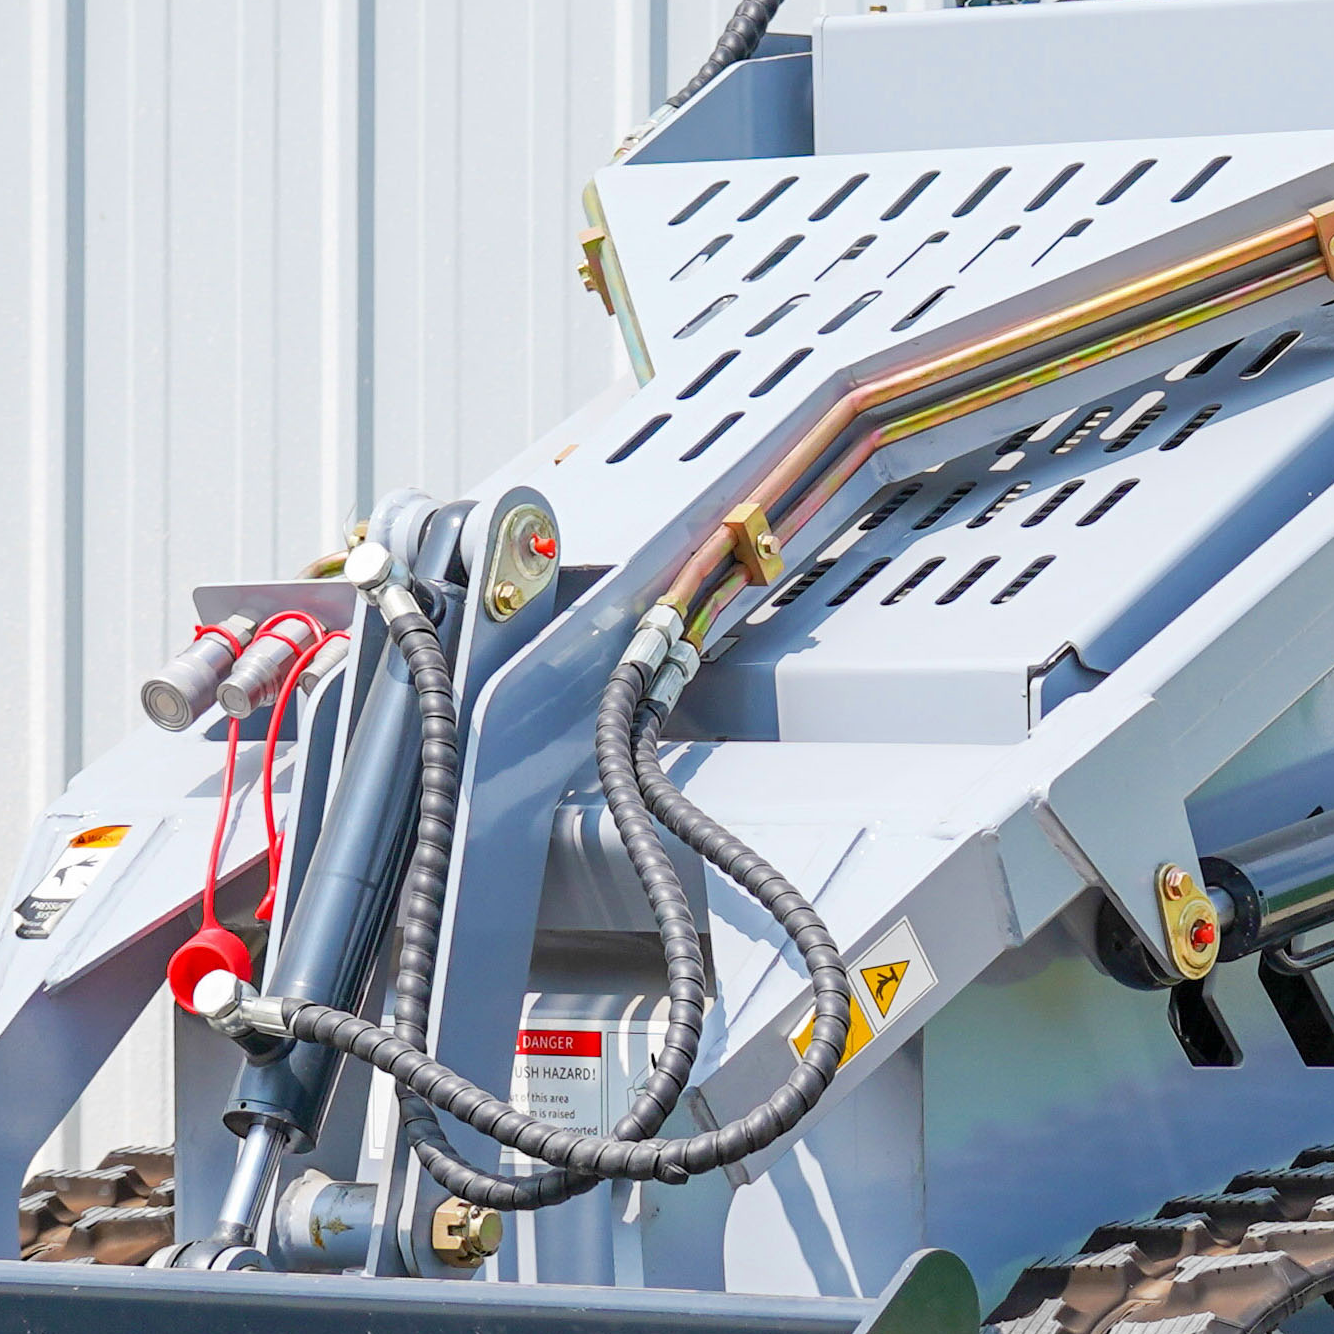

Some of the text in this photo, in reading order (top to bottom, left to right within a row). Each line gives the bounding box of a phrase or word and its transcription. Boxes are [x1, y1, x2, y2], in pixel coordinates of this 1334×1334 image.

[522, 1035, 574, 1050] DANGER
[514, 1066, 596, 1081] USH HAZARD!
[531, 1091, 548, 1103] this
[550, 1094, 569, 1104] area
[539, 1109, 547, 1119] is
[548, 1109, 576, 1120] raised
